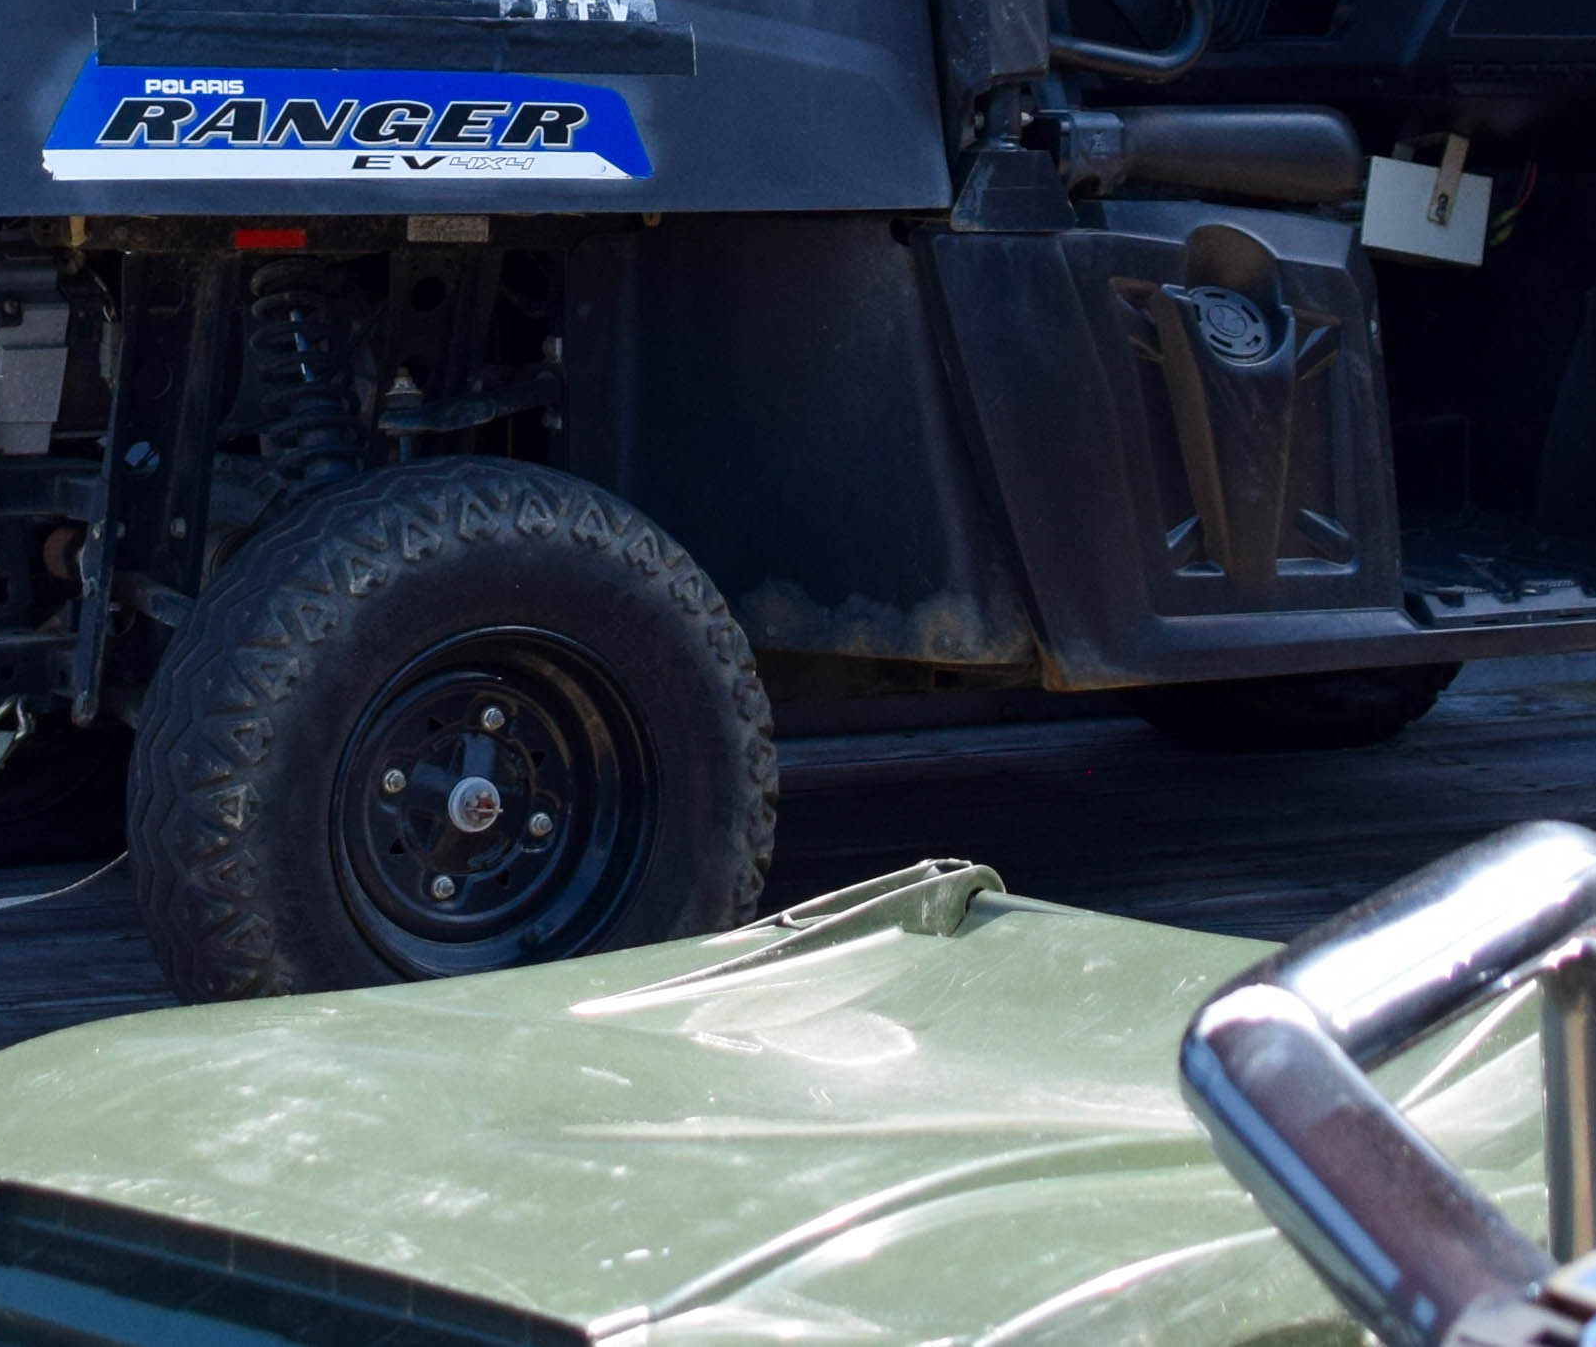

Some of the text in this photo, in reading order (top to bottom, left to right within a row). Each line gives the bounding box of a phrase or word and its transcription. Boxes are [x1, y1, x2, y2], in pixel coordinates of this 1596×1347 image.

[145, 79, 245, 95] POLARIS
[95, 98, 589, 149] RANGER
[350, 155, 448, 170] EV
